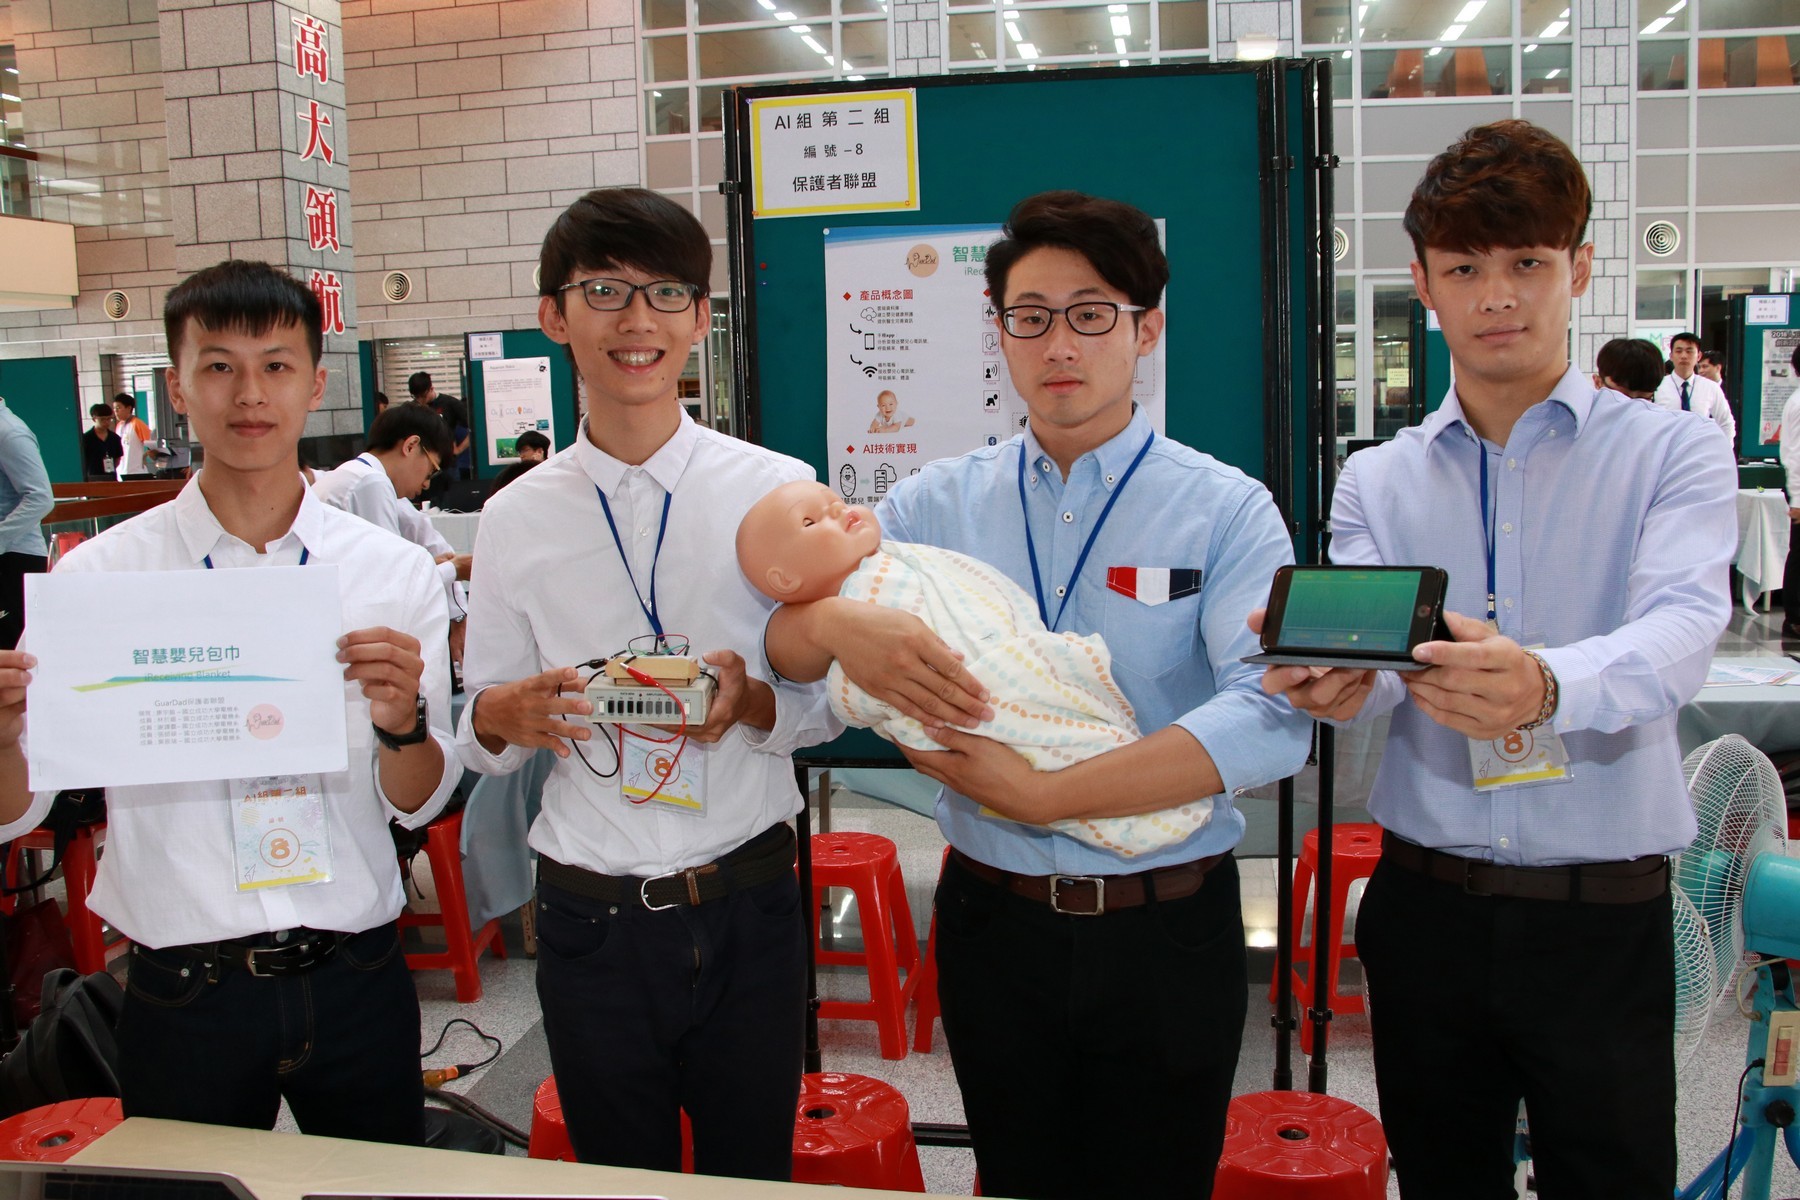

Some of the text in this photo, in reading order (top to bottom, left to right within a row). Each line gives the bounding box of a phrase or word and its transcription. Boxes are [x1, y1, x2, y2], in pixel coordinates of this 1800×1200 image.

[292, 14, 345, 334] 高大領航
[792, 171, 877, 193] 保護者聯盟
[859, 288, 914, 301] 產品概念圖
[863, 443, 918, 454] AI技術實現
[132, 645, 240, 665] 智慧嬰兒包巾
[196, 669, 231, 679] Blanket
[1503, 731, 1524, 754] 8
[654, 757, 672, 778] 8
[270, 838, 291, 860] 8
